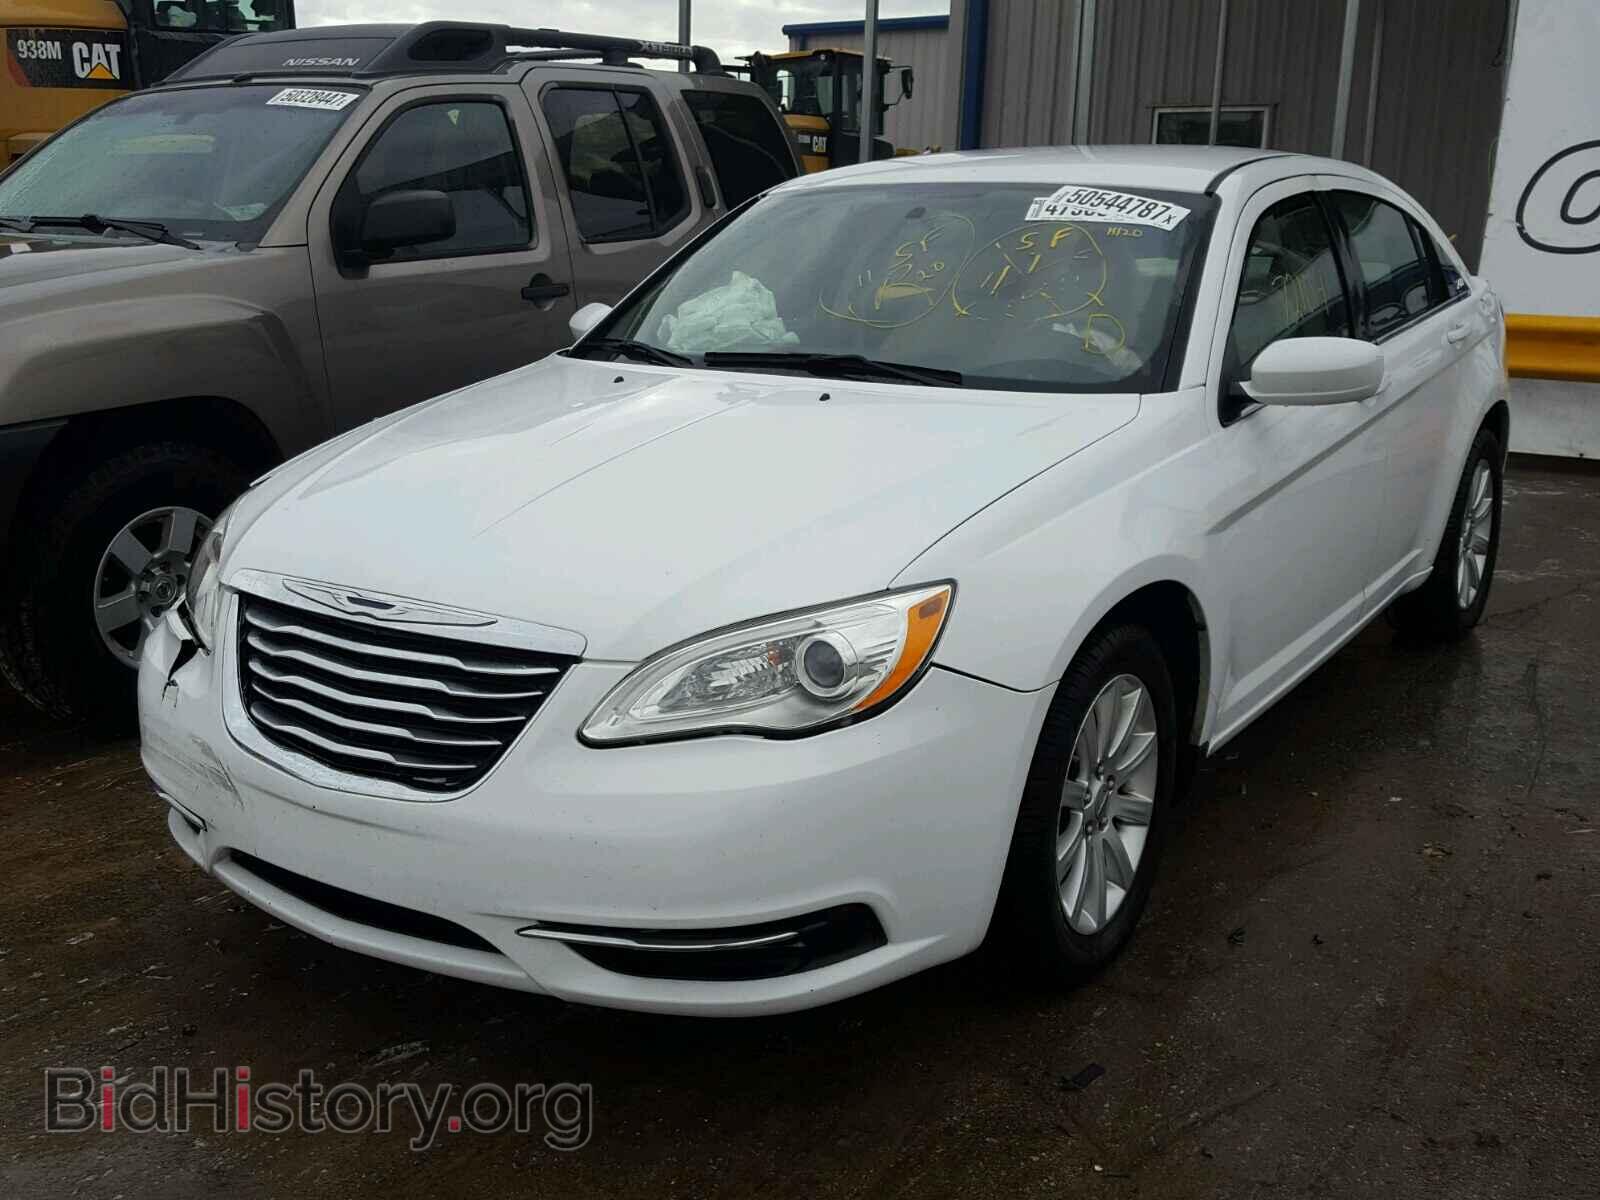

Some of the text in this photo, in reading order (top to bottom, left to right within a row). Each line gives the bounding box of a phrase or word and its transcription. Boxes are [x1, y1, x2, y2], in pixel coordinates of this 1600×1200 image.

[17, 39, 120, 80] 938M CAT
[281, 57, 360, 67] NISSAN
[812, 135, 828, 152] CAT
[1067, 189, 1171, 220] 50544787
